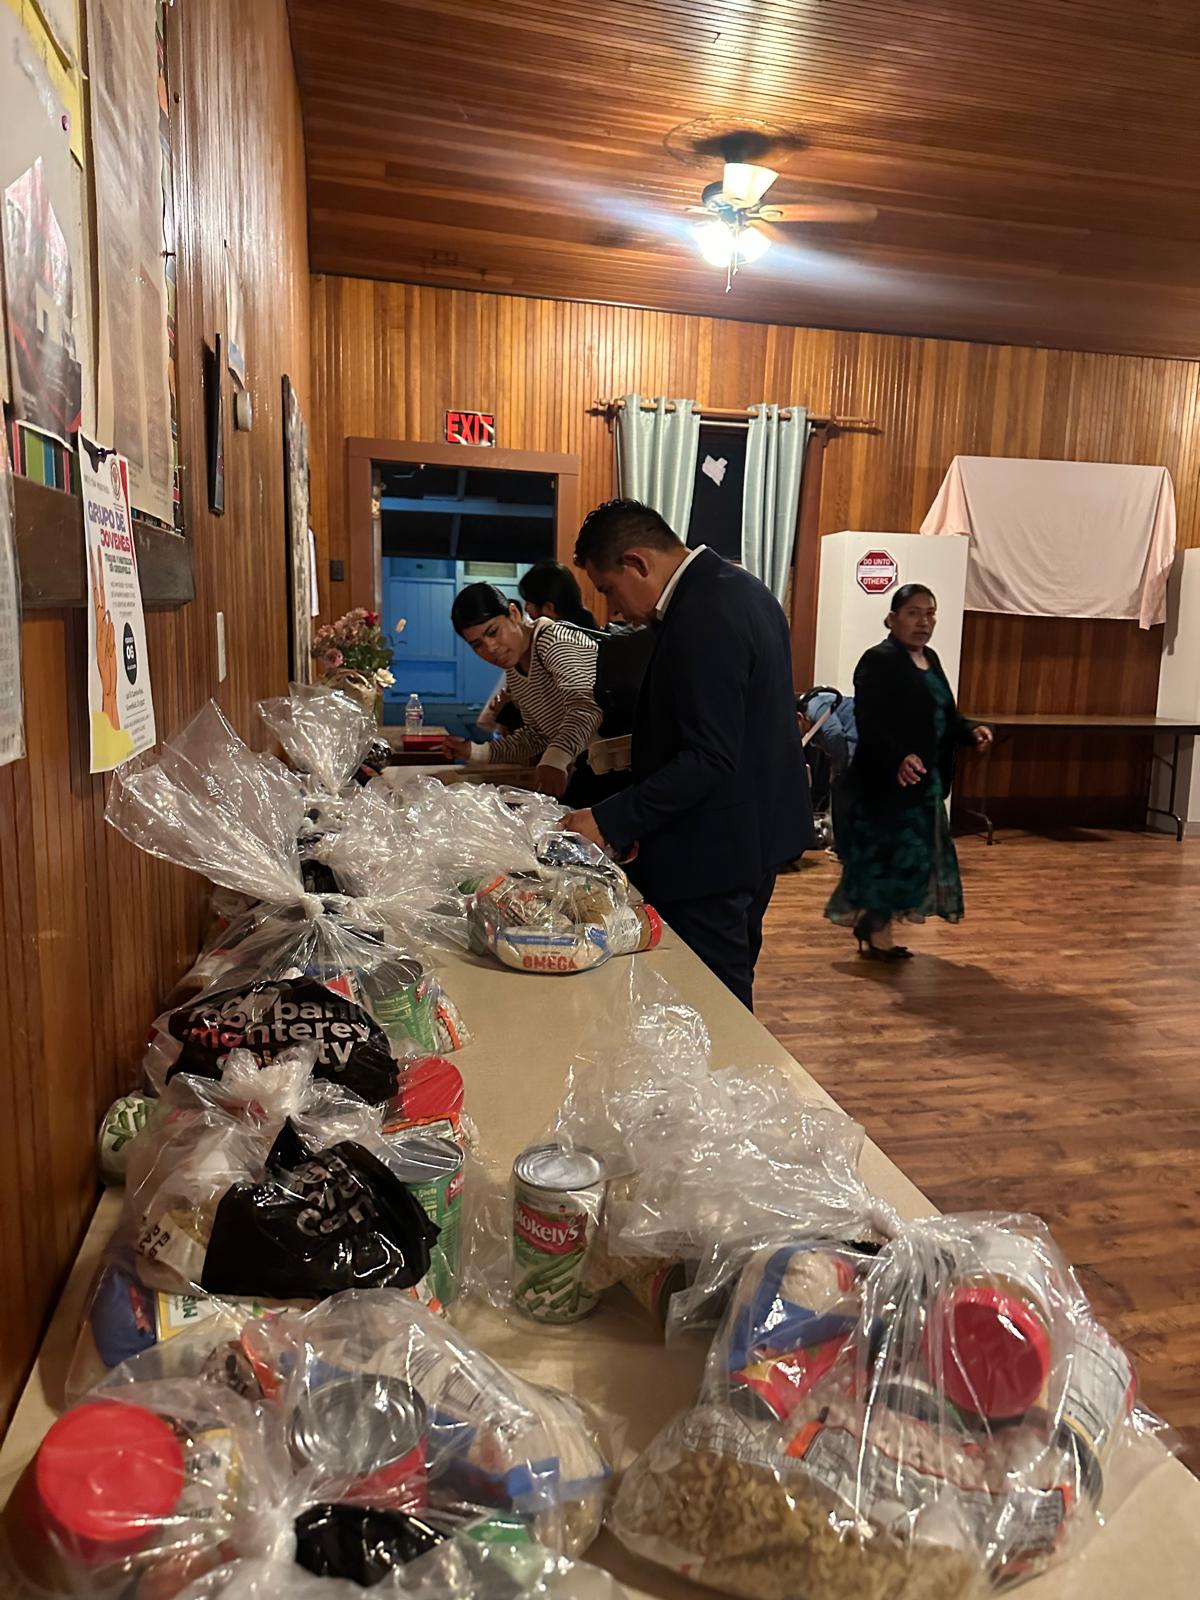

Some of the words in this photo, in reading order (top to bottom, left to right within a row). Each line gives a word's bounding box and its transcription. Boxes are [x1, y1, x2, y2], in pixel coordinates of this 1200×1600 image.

[447, 412, 493, 444] EXIT
[88, 500, 115, 529] GRUPO
[114, 511, 126, 532] DE
[862, 577, 889, 585] OTHERS
[522, 955, 578, 971] OMEGA
